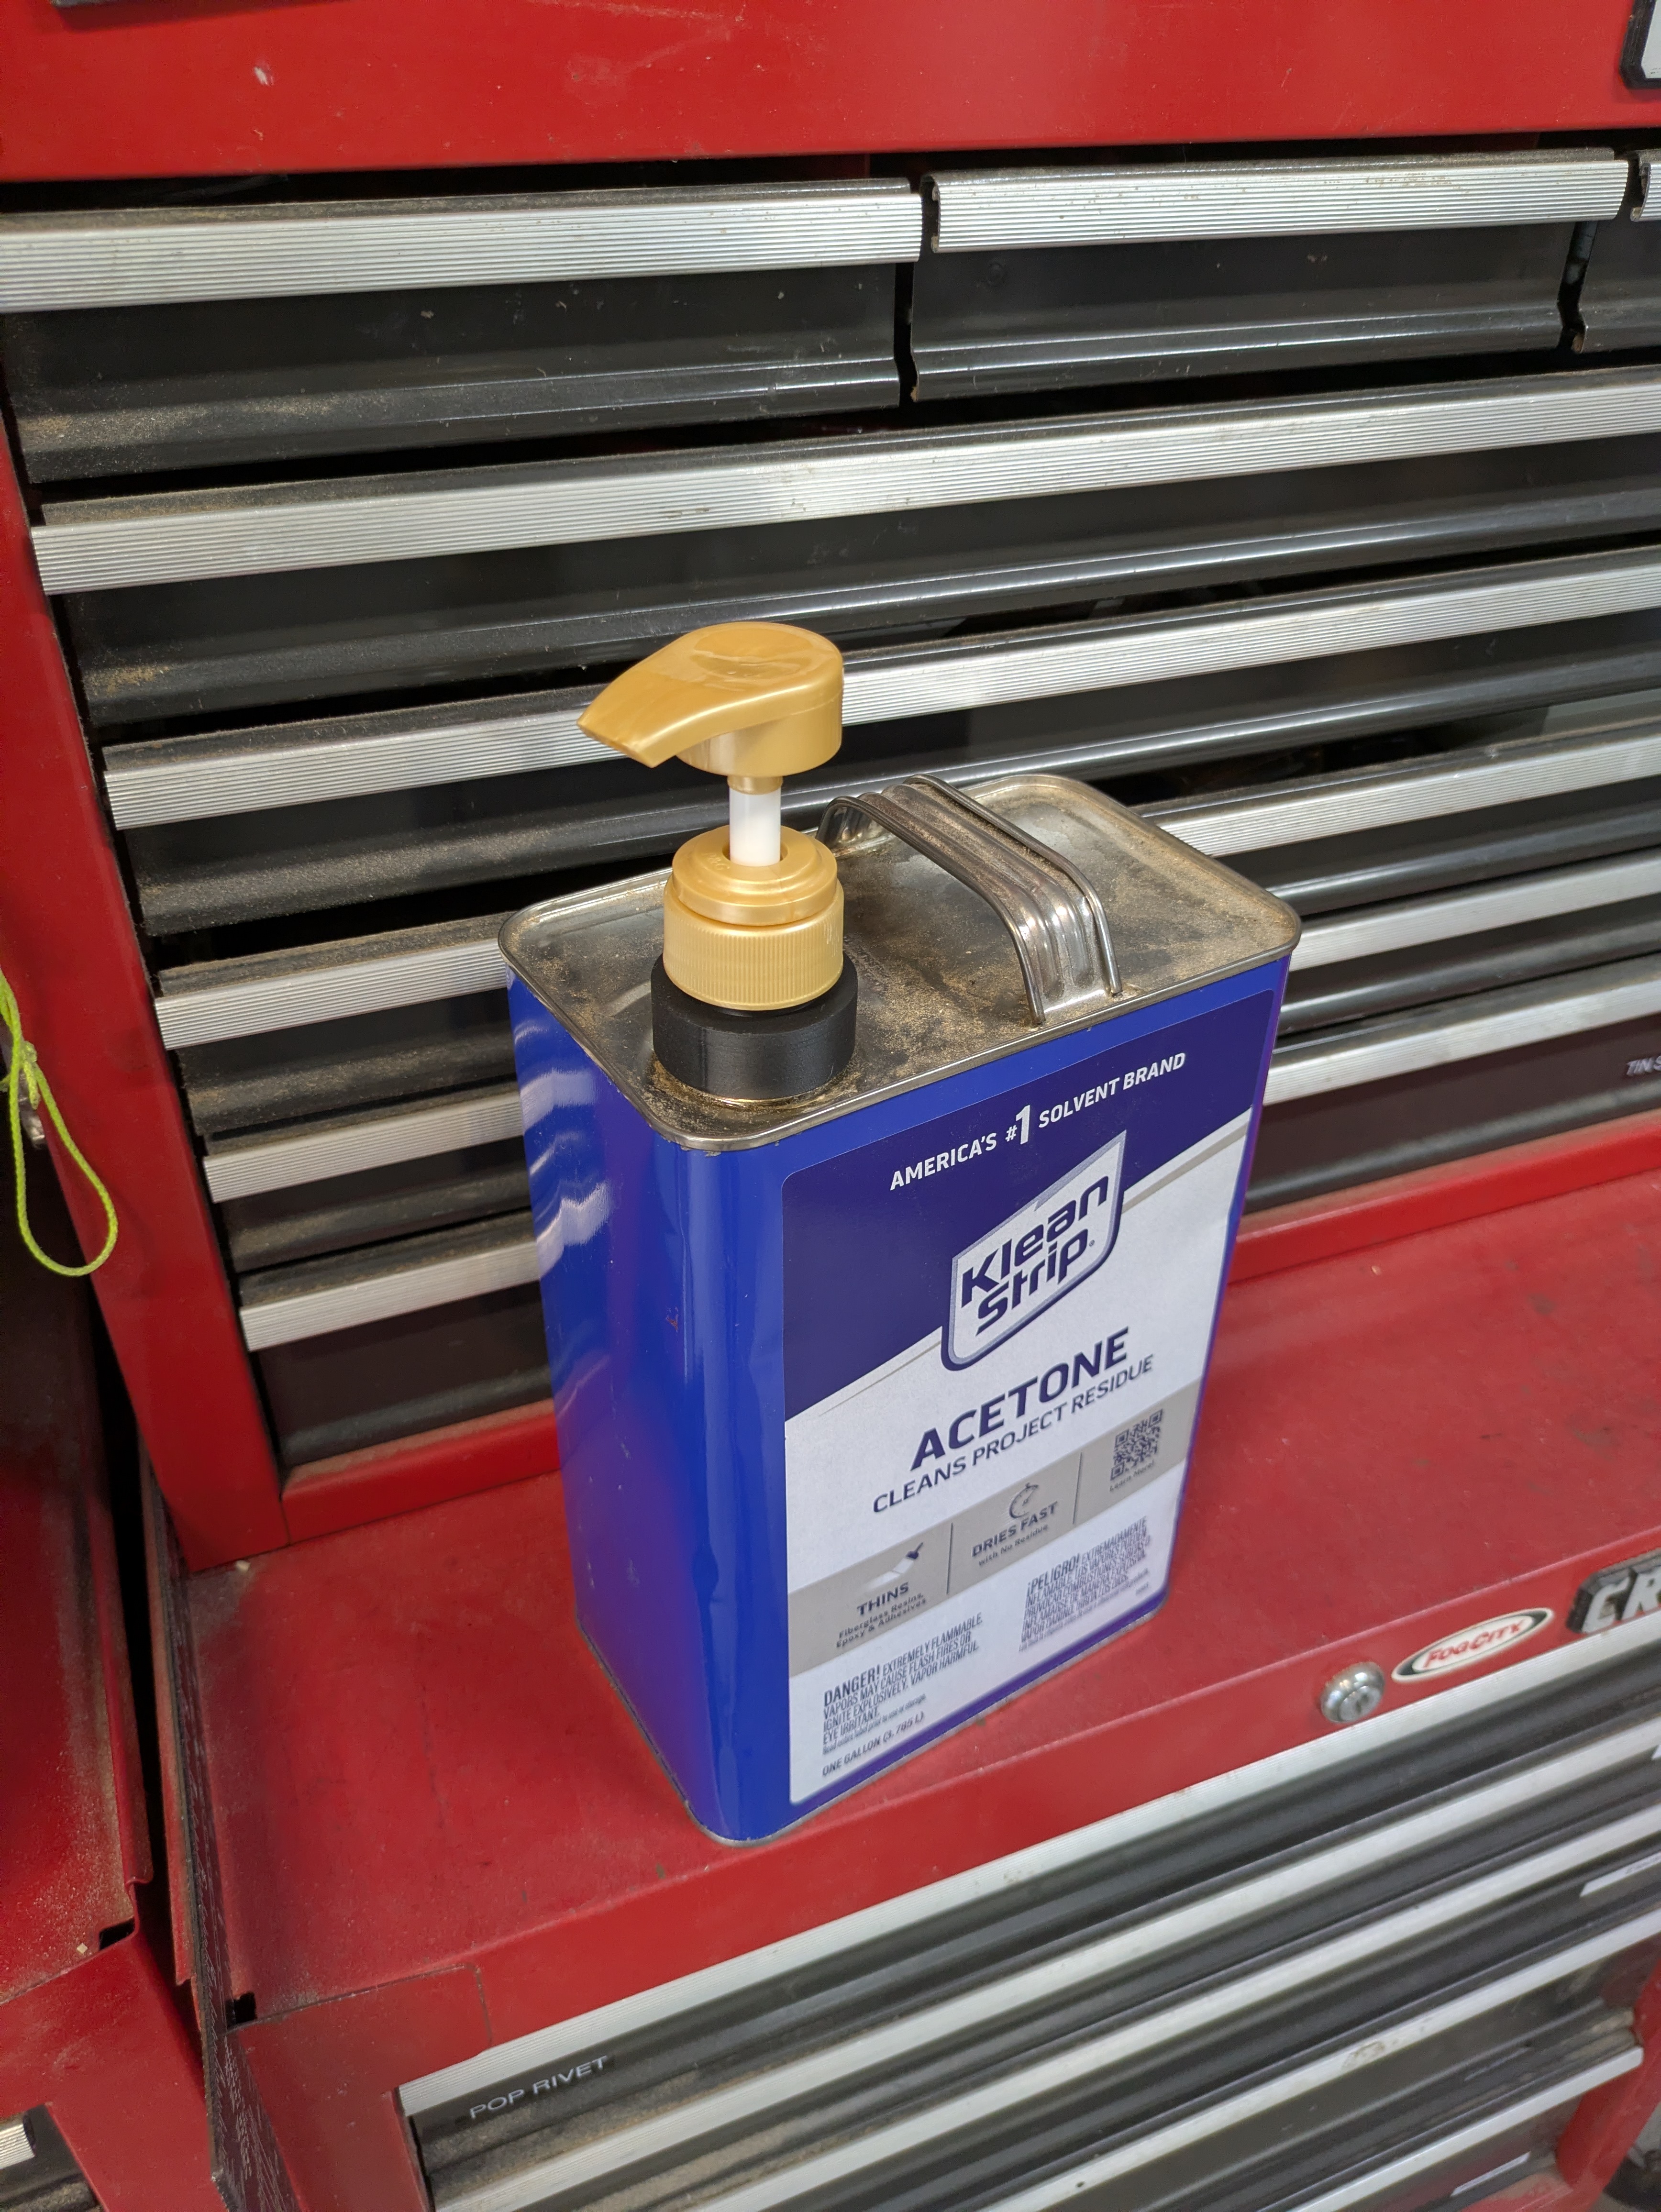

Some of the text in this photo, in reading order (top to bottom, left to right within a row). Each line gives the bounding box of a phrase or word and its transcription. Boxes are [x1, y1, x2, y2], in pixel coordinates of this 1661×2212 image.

[890, 1052, 1185, 1190] AMERICA'S #1 SOLVENT BRAND
[962, 1175, 1108, 1307] Klean
[910, 1326, 1129, 1471] ACETONE
[873, 1354, 1154, 1513] CLEANS PROJECT RESIDUE
[972, 1501, 1057, 1558] DRIES FAST
[978, 1523, 1048, 1567] with No Residue
[836, 1597, 926, 1648] Epoxy & Adhesives
[839, 1609, 888, 1639] Fiberglass
[856, 1582, 908, 1615] THINS
[823, 1630, 971, 1720] VAPORS MAY CAUSE FLASH FIRES OR
[823, 1707, 851, 1733] IGNITE
[1021, 1619, 1045, 1642] VAPOR
[824, 1663, 880, 1707] DANGER!
[883, 1640, 930, 1676] EXTREMELY
[822, 1758, 841, 1777] ONE
[844, 1735, 880, 1764] GALLON
[823, 1703, 880, 1746] EYE IRRITANT.
[469, 2055, 607, 2119] POP RIVET
